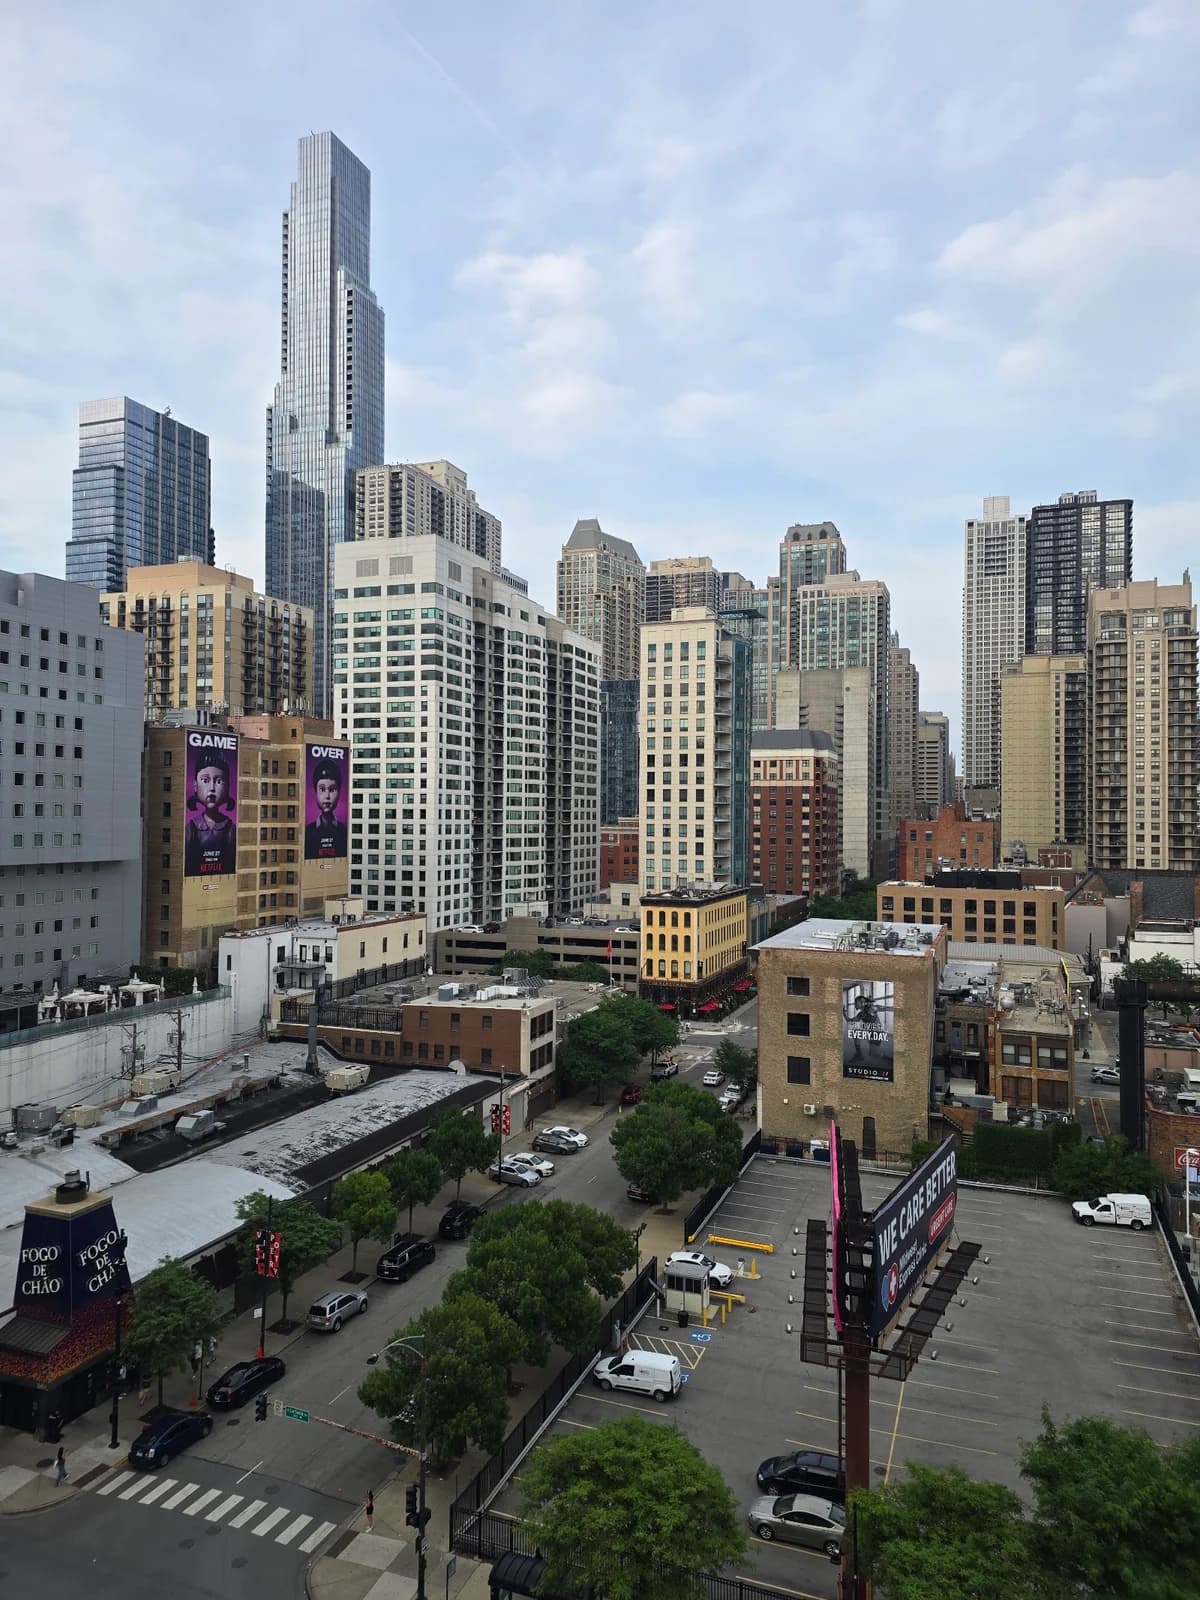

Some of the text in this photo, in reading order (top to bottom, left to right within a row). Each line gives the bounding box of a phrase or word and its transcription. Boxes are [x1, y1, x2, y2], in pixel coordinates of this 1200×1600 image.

[189, 733, 236, 750] GAME
[311, 746, 344, 759] OVER
[848, 1067, 878, 1076] STUDIO
[879, 1216, 898, 1266] WE
[900, 1185, 924, 1240] CARE
[926, 1151, 956, 1209] BETTER
[22, 1246, 59, 1263] FOGO
[80, 1230, 117, 1266] FOGO
[96, 1252, 111, 1270] DE
[33, 1264, 47, 1277] DE
[88, 1262, 117, 1292] CHÃ
[22, 1275, 60, 1295] CHÃO
